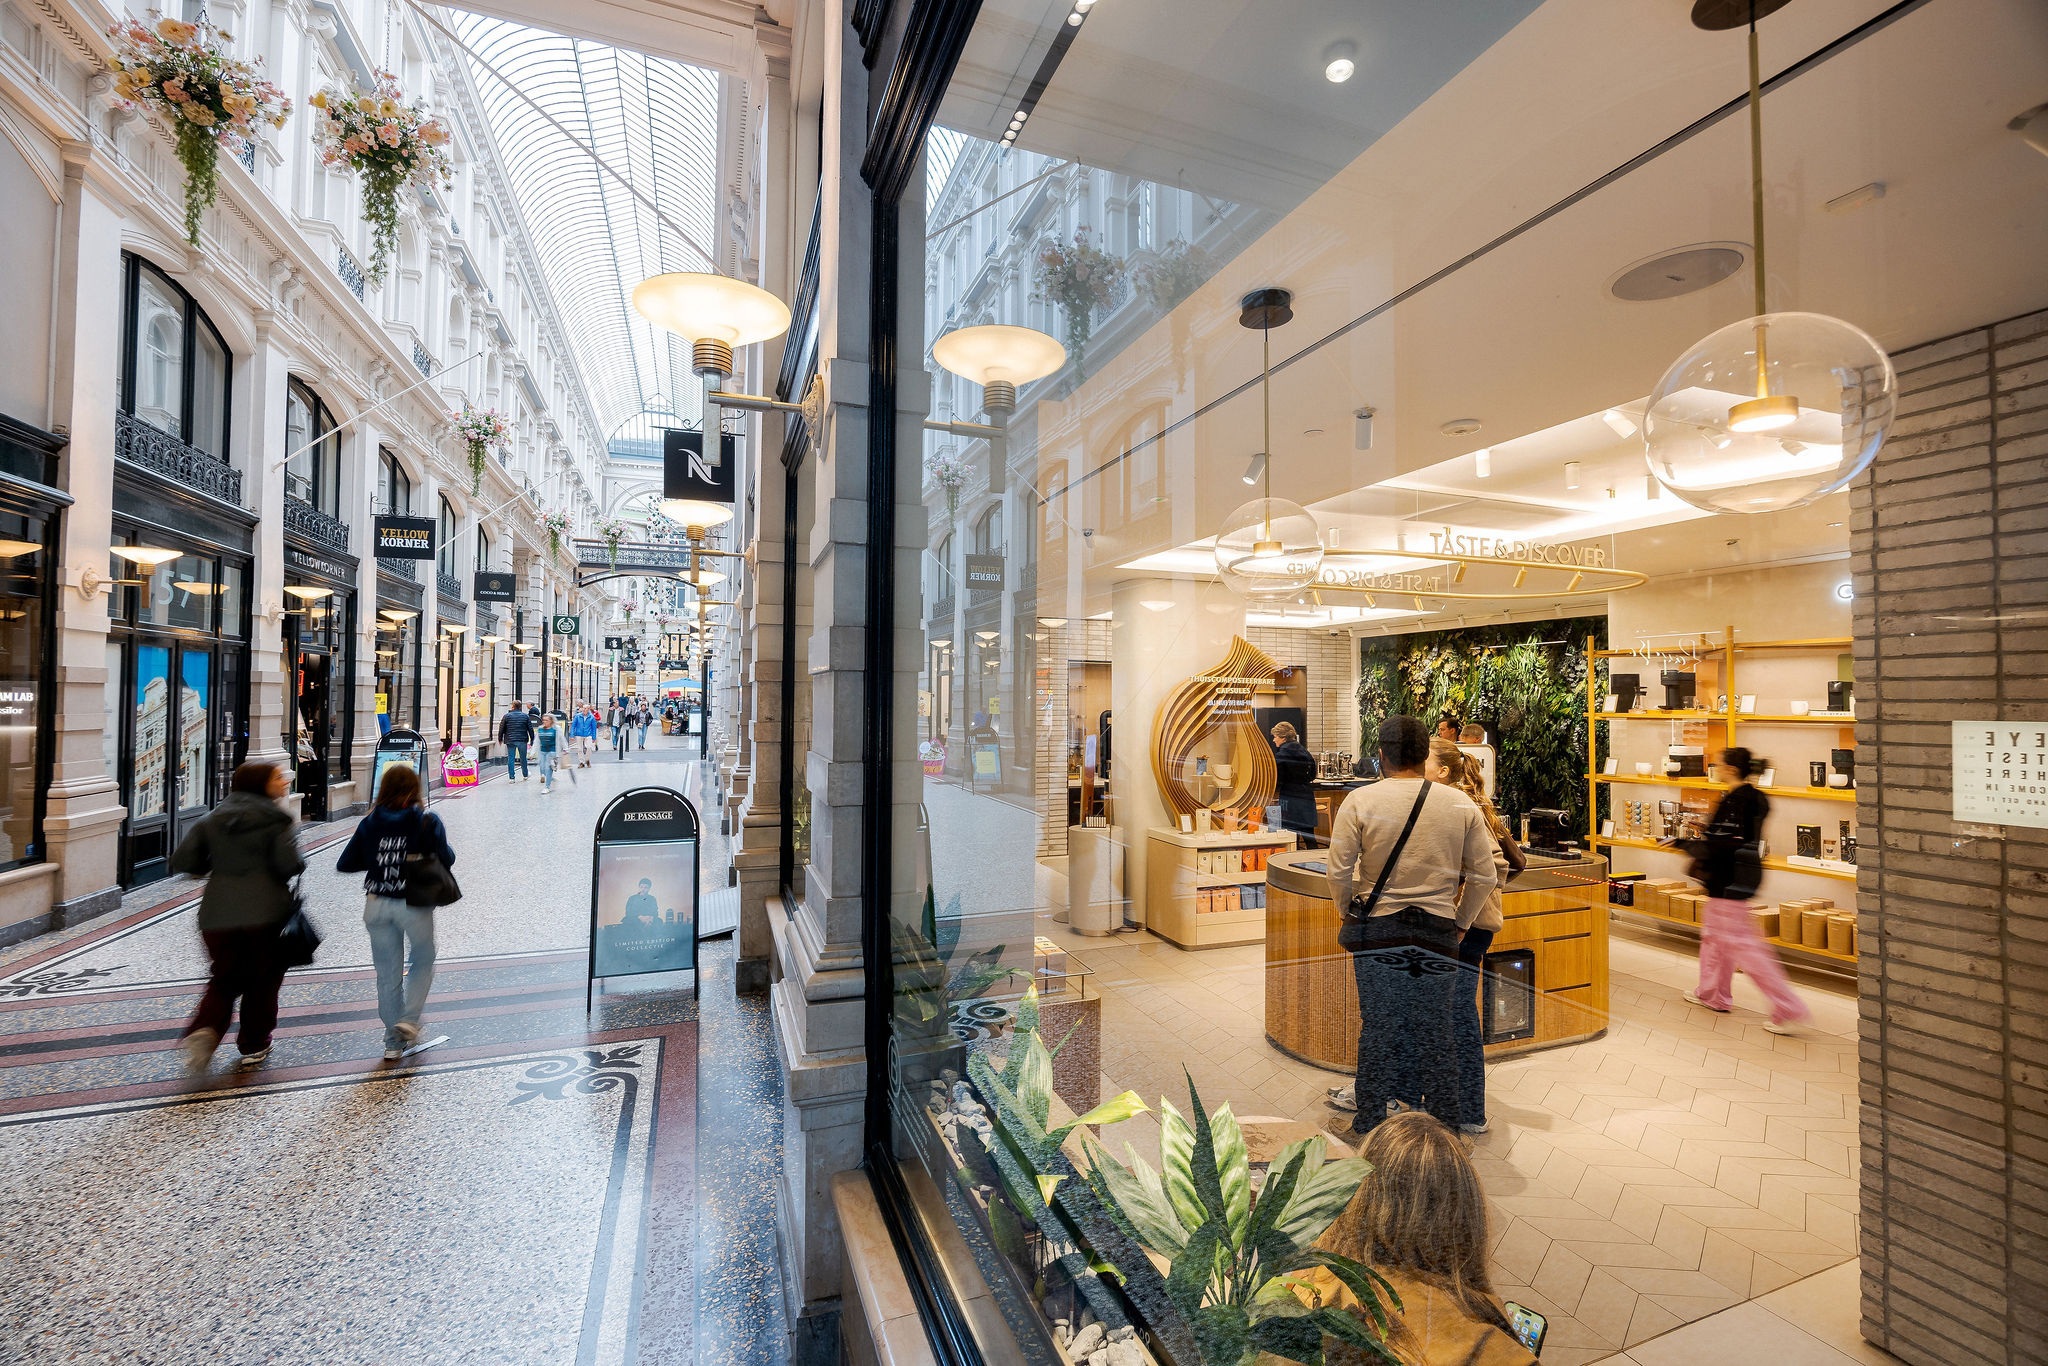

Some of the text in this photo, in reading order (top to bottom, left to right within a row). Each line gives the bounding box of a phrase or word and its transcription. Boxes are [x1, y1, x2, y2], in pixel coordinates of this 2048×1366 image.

[380, 527, 429, 539] YELLOW
[380, 537, 429, 549] KORNER
[1429, 532, 1606, 568] TASTE & DISCOVER
[291, 551, 346, 579] YELLOWKORNER
[158, 569, 195, 608] 57
[14, 692, 34, 701] LAB
[624, 811, 673, 821] DE PASSAGE
